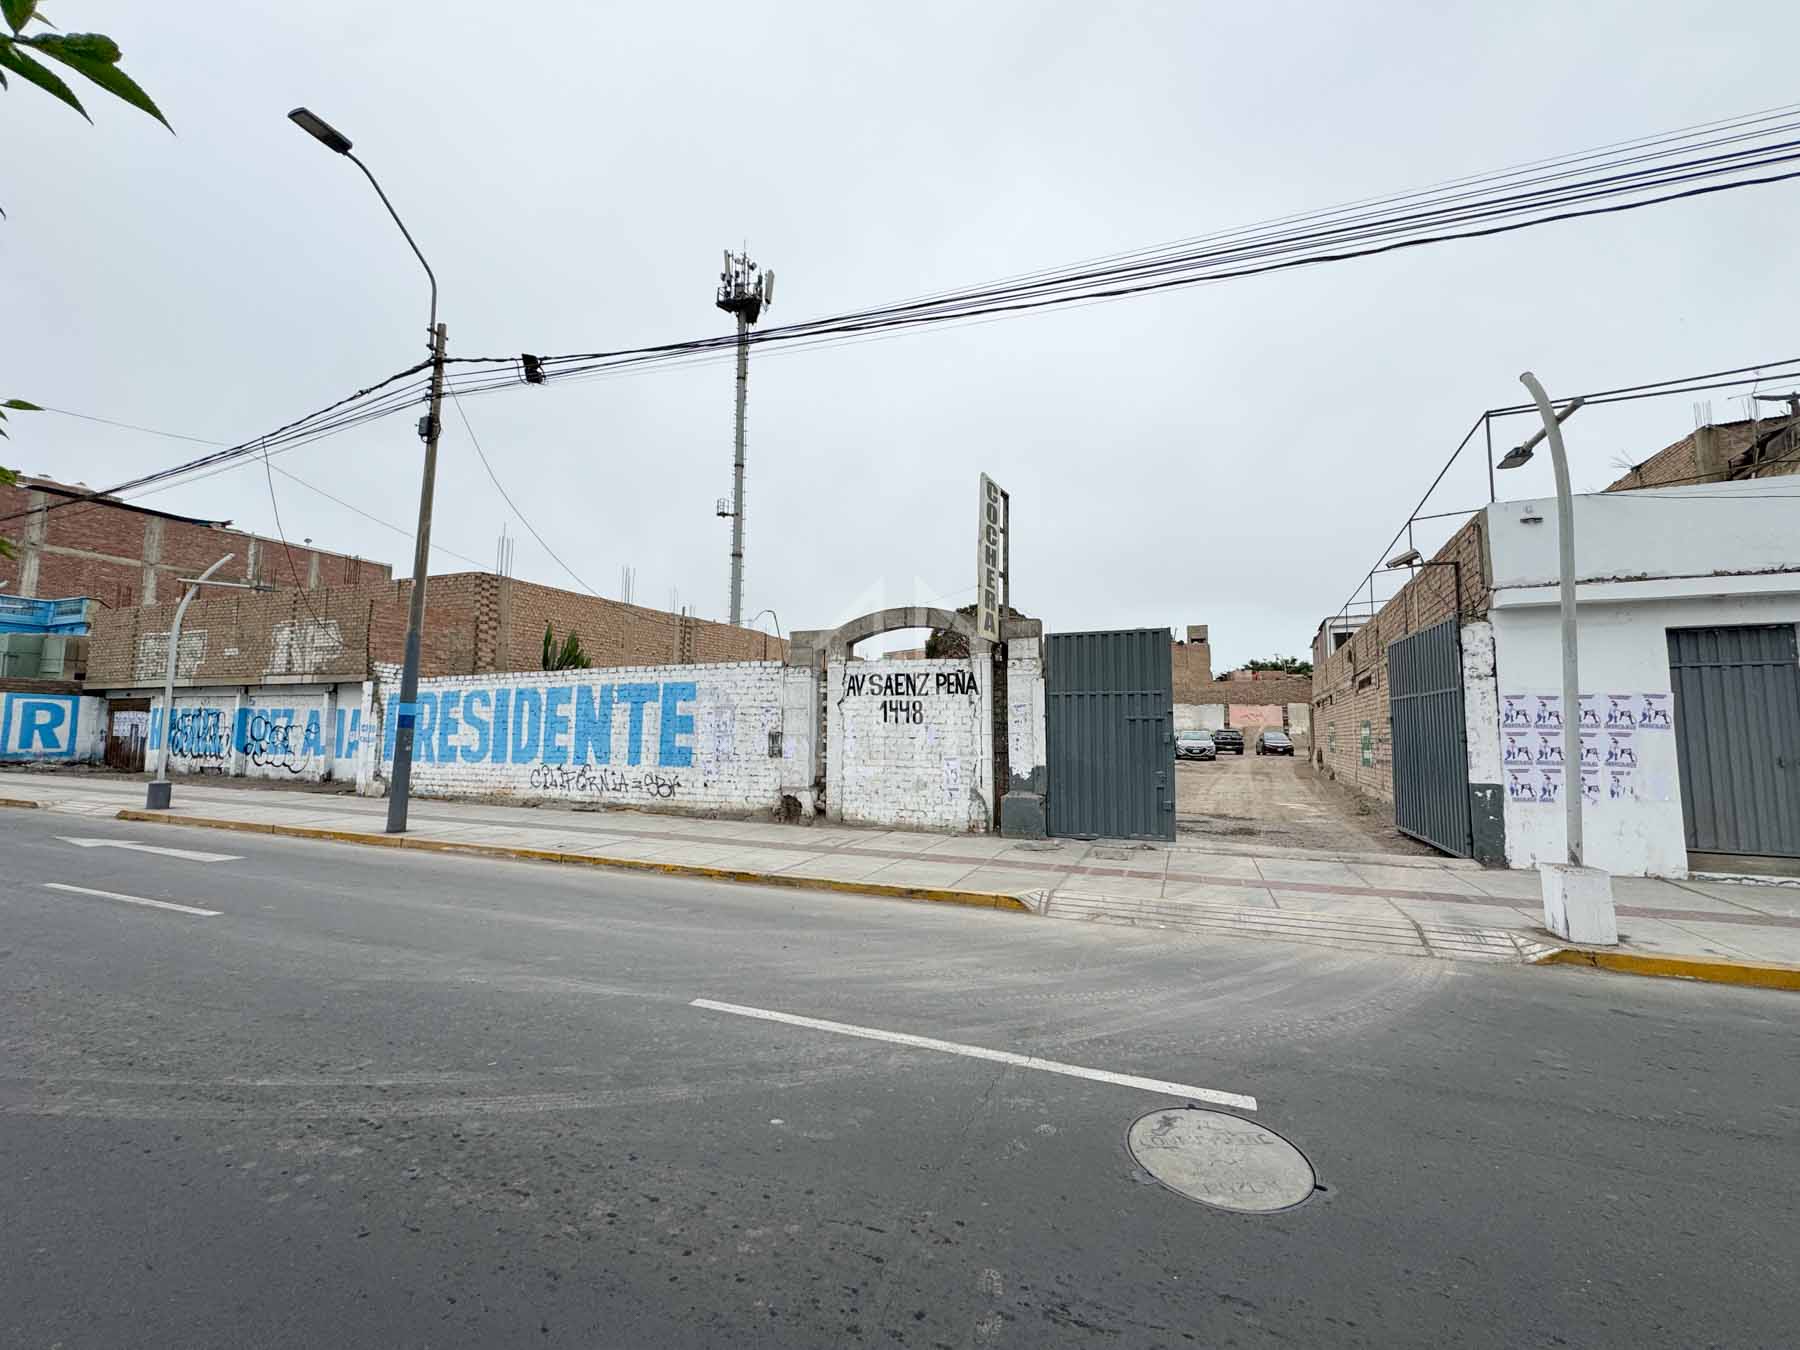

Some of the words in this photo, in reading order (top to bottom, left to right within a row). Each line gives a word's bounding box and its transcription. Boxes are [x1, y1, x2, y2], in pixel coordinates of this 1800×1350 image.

[983, 481, 998, 634] COCHERA
[936, 669, 979, 696] PEÑA
[880, 700, 924, 725] 1448
